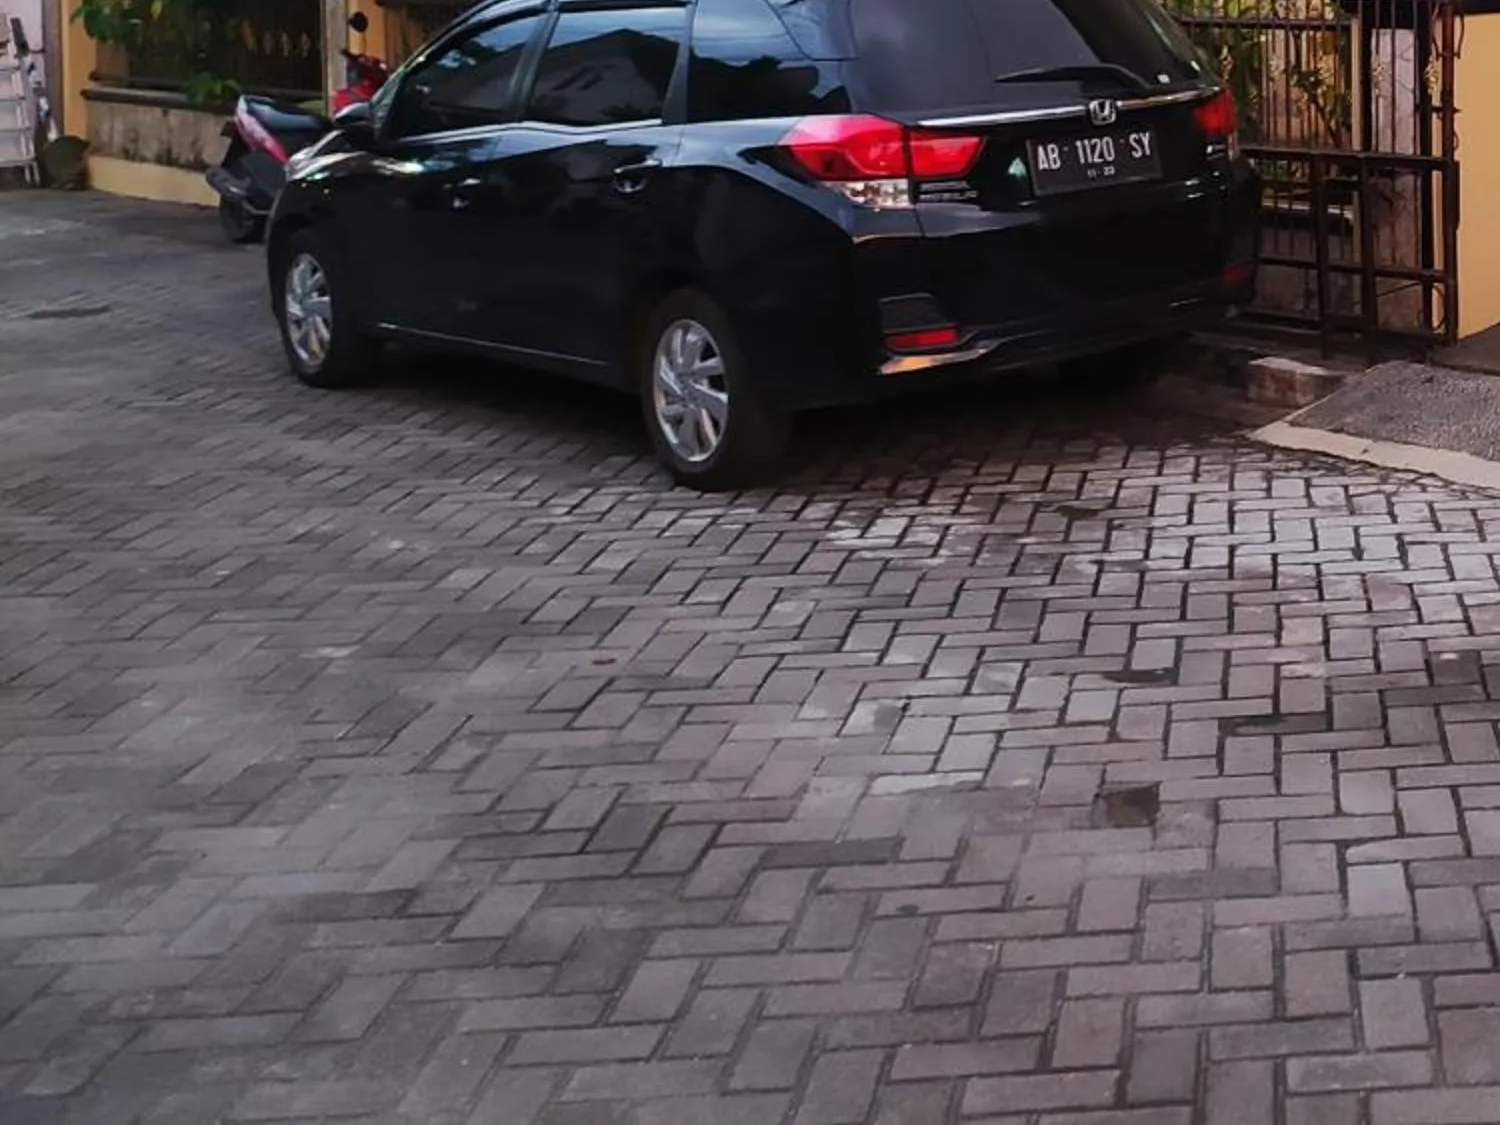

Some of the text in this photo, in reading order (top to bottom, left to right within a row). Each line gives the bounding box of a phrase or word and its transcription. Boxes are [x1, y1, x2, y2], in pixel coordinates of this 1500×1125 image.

[1038, 131, 1151, 170] AB 1120 SY
